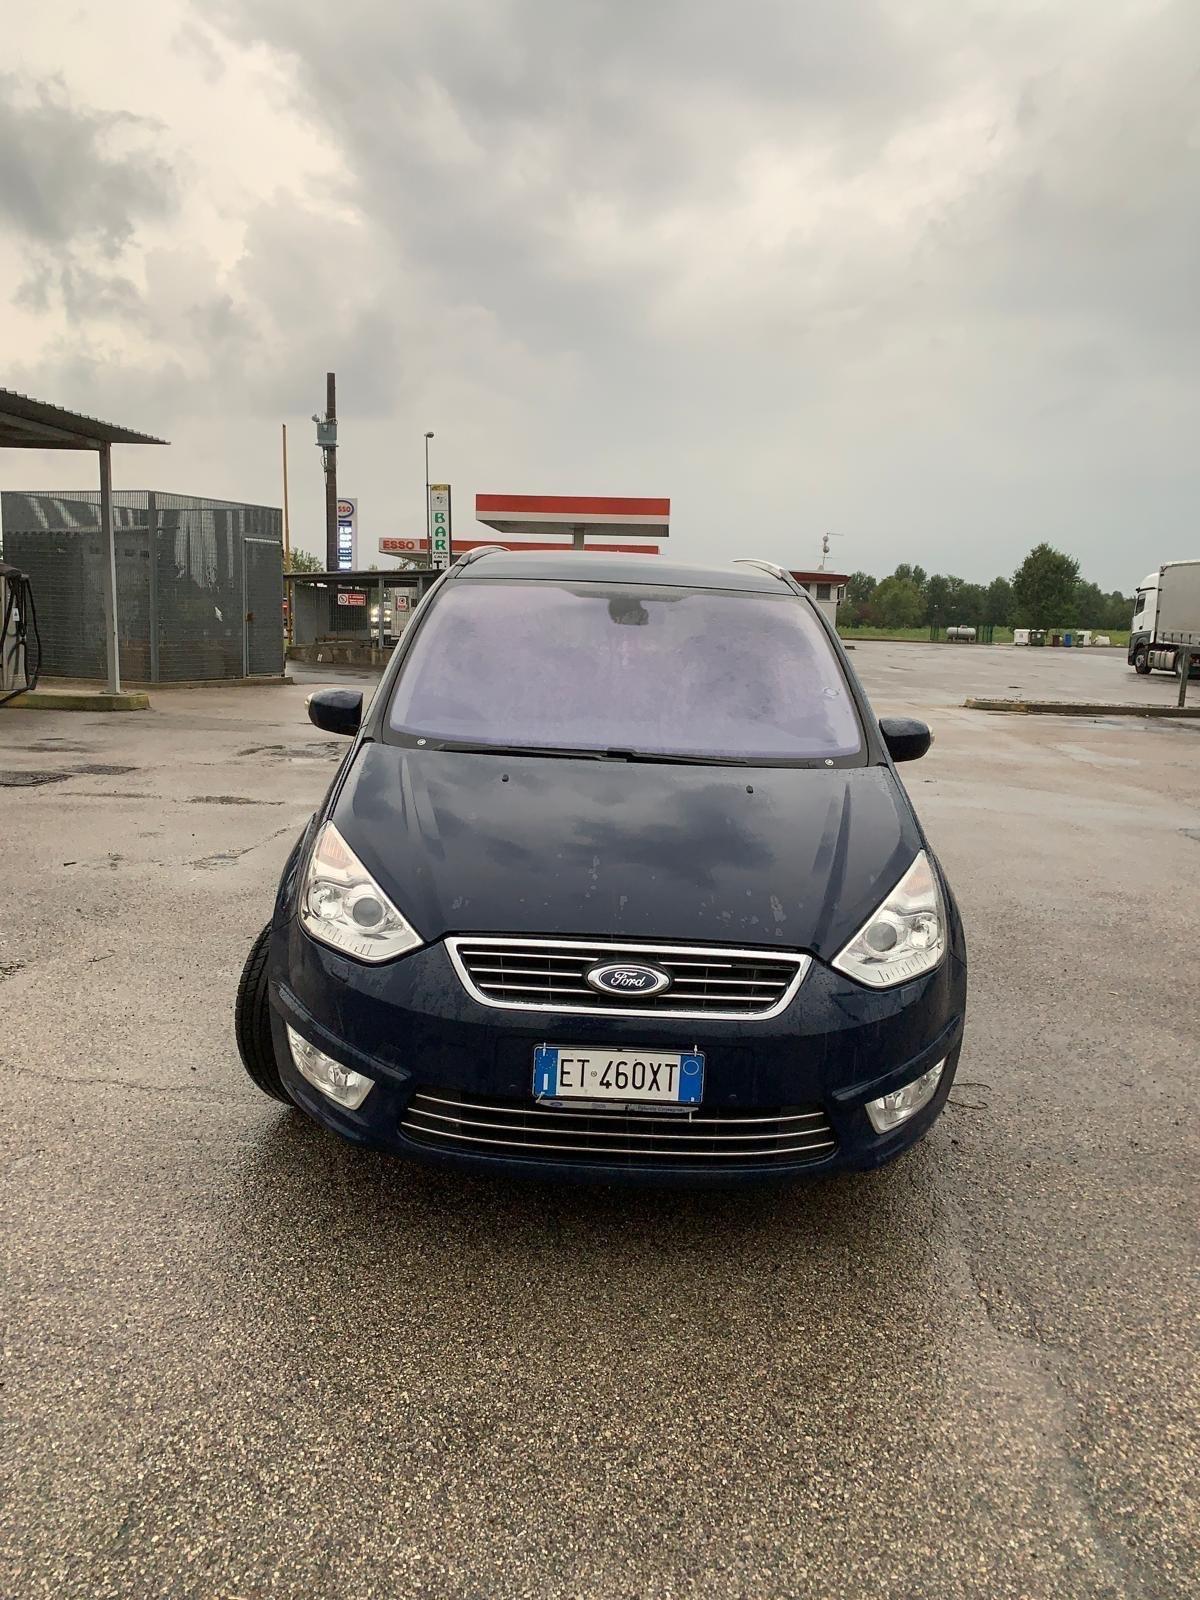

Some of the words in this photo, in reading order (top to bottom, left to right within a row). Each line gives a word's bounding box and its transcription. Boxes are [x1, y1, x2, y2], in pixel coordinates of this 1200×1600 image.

[434, 512, 446, 550] BAR
[382, 540, 415, 550] ESSO
[611, 971, 646, 987] Ford
[559, 1058, 590, 1088] ET
[599, 1060, 678, 1093] 460XT
